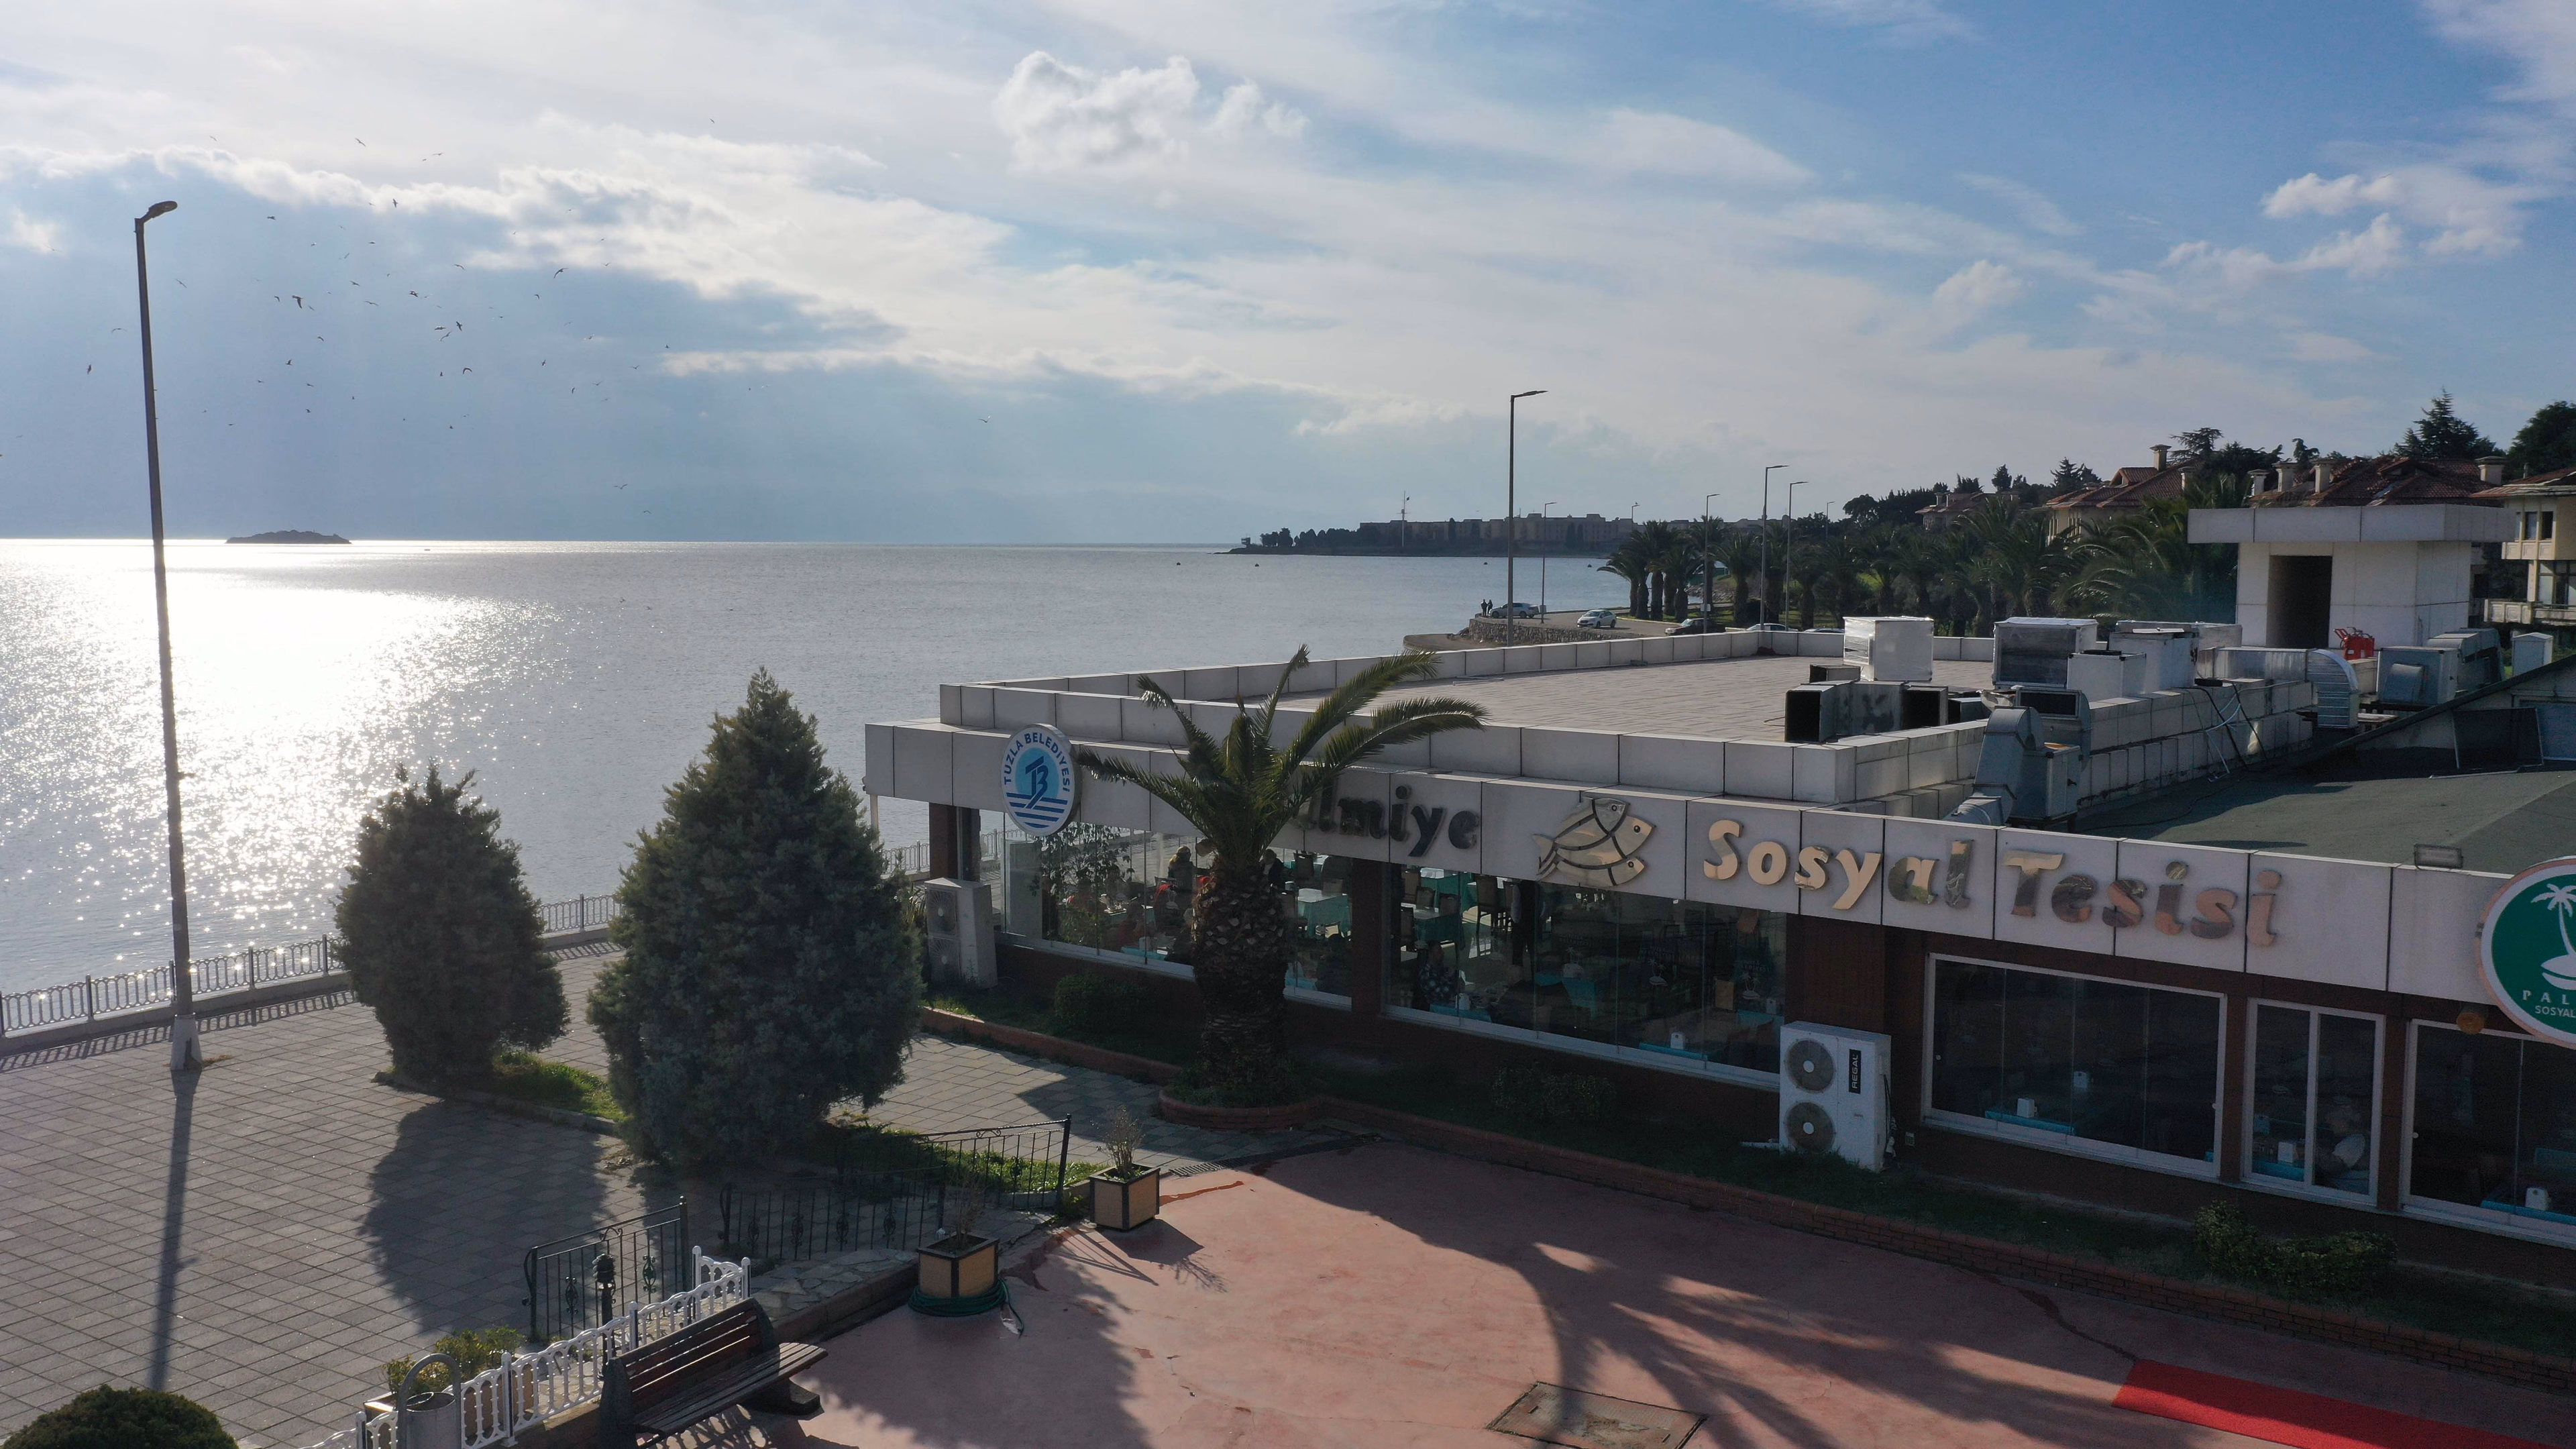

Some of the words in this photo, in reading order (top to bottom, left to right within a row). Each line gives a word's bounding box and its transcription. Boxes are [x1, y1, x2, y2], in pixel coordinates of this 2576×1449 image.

[1004, 741, 1024, 785] TUZLA
[1024, 733, 1070, 792] BELEDİYESİ
[1299, 773, 1480, 857] lmiye
[1703, 819, 1974, 910] Sosyal
[2003, 849, 2282, 947] Tesisi
[2534, 1005, 2576, 1018] SOSYAL
